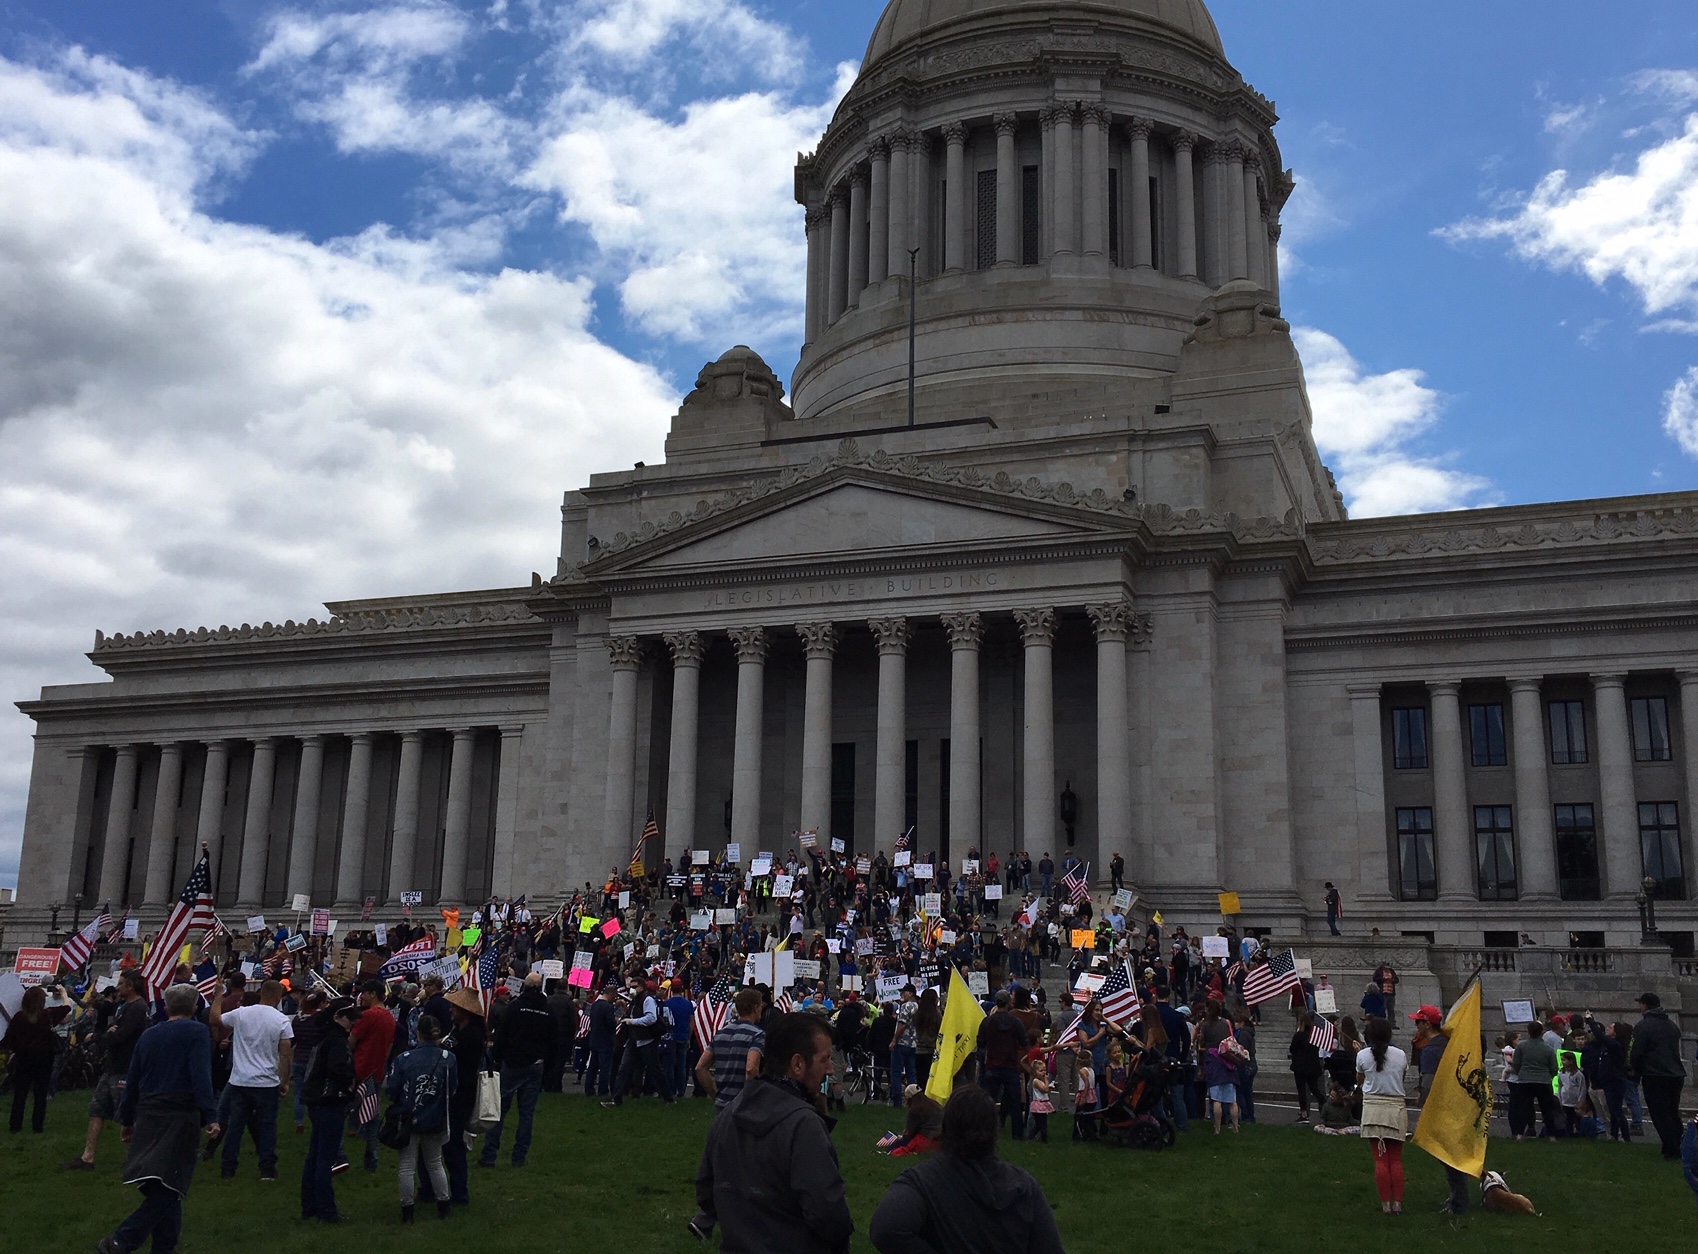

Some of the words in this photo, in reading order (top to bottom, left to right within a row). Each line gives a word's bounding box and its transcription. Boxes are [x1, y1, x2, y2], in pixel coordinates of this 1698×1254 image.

[714, 583, 857, 605] LEGISLATIVE
[887, 573, 999, 594] BUILDING
[21, 960, 53, 968] FREE!
[883, 977, 901, 986] FREE
